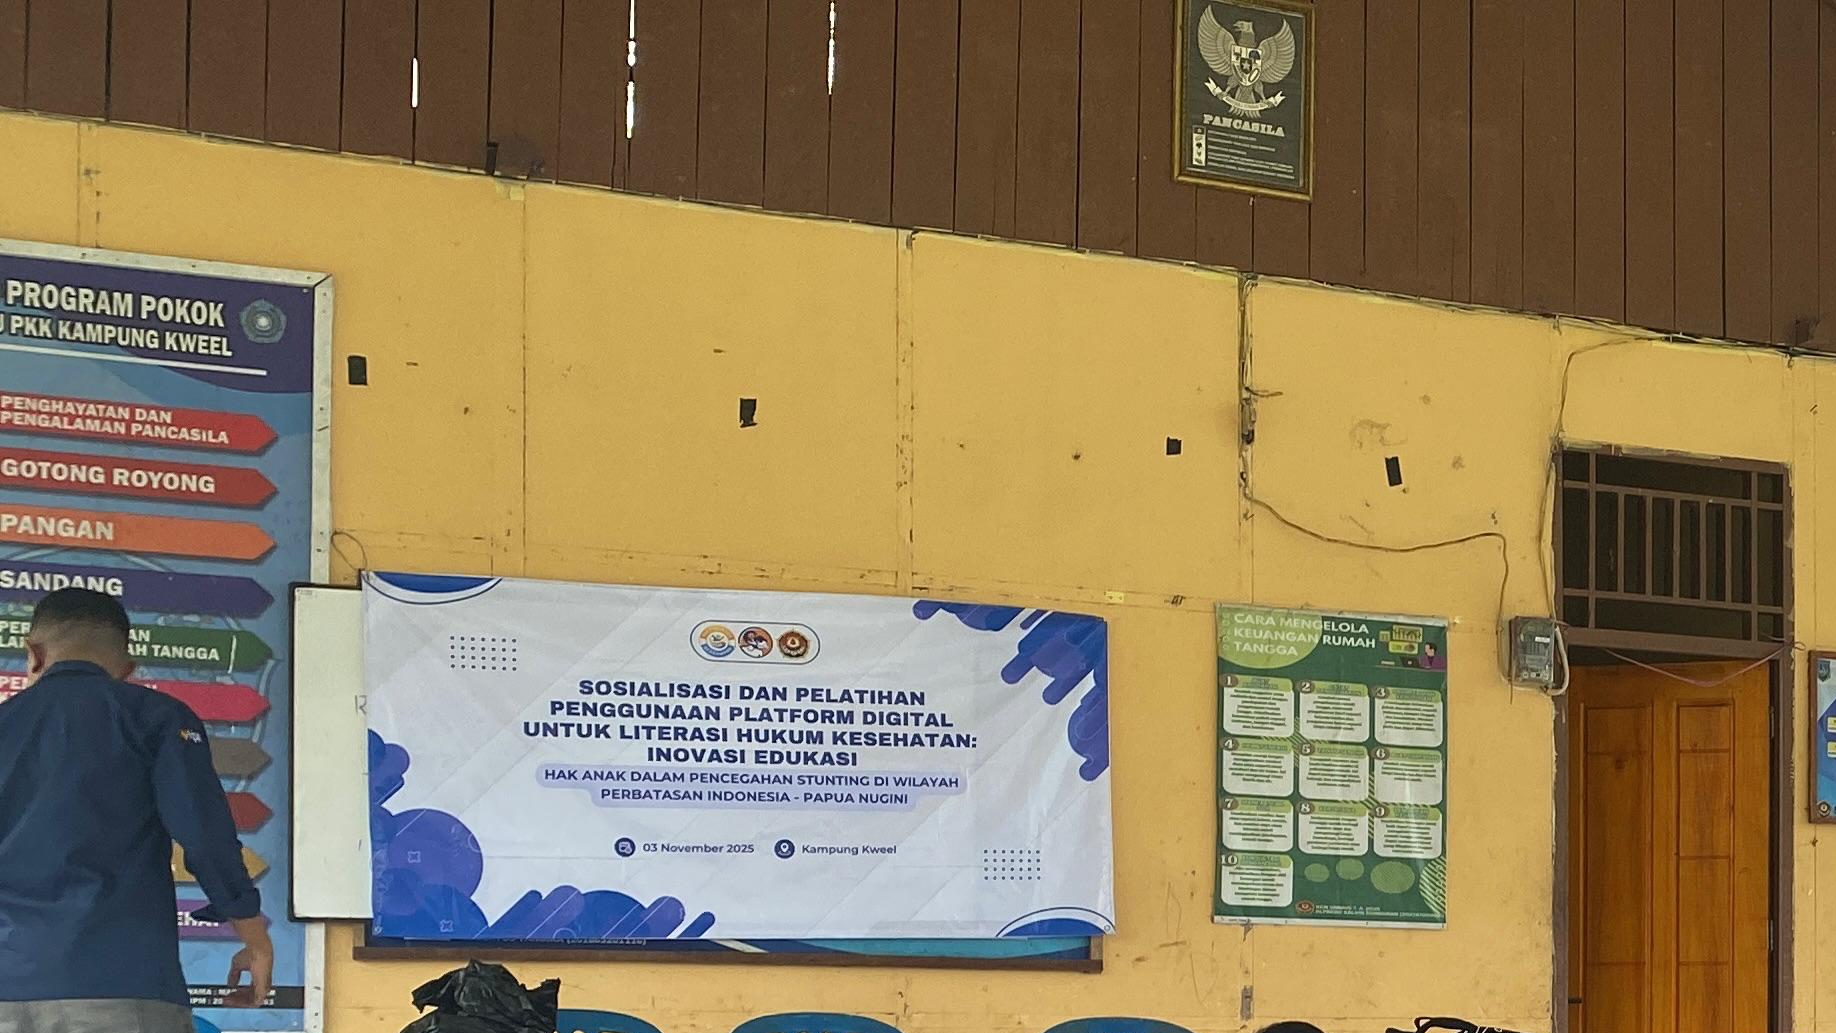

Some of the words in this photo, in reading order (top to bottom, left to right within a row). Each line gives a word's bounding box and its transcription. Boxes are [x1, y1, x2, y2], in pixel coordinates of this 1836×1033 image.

[1203, 113, 1286, 137] PANCASILA
[6, 279, 133, 318] PROGRAM
[140, 294, 225, 328] POKOK
[10, 314, 53, 338] PKK
[58, 318, 160, 349] KAMPUNG
[165, 331, 233, 357] KWEEL
[0, 394, 130, 420] PENGHAYATAN
[135, 407, 173, 424] DAN
[0, 410, 126, 435] PENGALAMAN
[131, 422, 229, 444] PANCASILA
[1, 458, 106, 485] GOTONG
[112, 469, 216, 494] ROYONG
[1, 513, 115, 541] PANGAN
[1234, 613, 1277, 627] CARA
[1279, 617, 1369, 635] MENGELOLA
[1234, 627, 1319, 643] KEUANGAN
[1322, 635, 1376, 649] RUMAH
[152, 644, 220, 660] TANGGA
[1234, 642, 1298, 656] TANGGA
[578, 680, 731, 700] SOSIALISASI
[739, 685, 787, 701] DAN
[795, 687, 925, 706] PELATIHAN
[1301, 682, 1311, 692] 2
[1376, 688, 1386, 698] 3
[550, 700, 721, 721] PENGGUNAAN
[729, 706, 855, 725] PLATFORM
[862, 710, 954, 728] DIGITAL
[523, 721, 612, 739] UNTUK
[619, 724, 728, 743] LITERASI
[737, 727, 826, 745] HUKUM
[832, 730, 977, 749] KESEHATAN:
[1223, 738, 1234, 749] 4
[647, 747, 746, 764] INOVASI
[754, 749, 858, 767] EDUKASI
[544, 769, 578, 781] HAK
[582, 770, 626, 782] ANAK
[631, 771, 685, 783] DALAM
[690, 772, 793, 786] PENCEGAHAN
[797, 774, 870, 787] STUNTING
[874, 775, 889, 787] DI
[893, 776, 960, 788] WILAYAH
[601, 788, 703, 801] PERBATASAN
[707, 790, 791, 803] INDONESIA
[804, 792, 855, 804] PAPUA
[858, 793, 908, 804] NUGINI
[1224, 799, 1233, 809] 7
[642, 843, 658, 853] 03
[661, 843, 724, 854] November
[727, 844, 755, 854] 2025
[802, 844, 859, 856] Kampung
[862, 845, 897, 854] Kweel
[1221, 854, 1238, 865] 10
